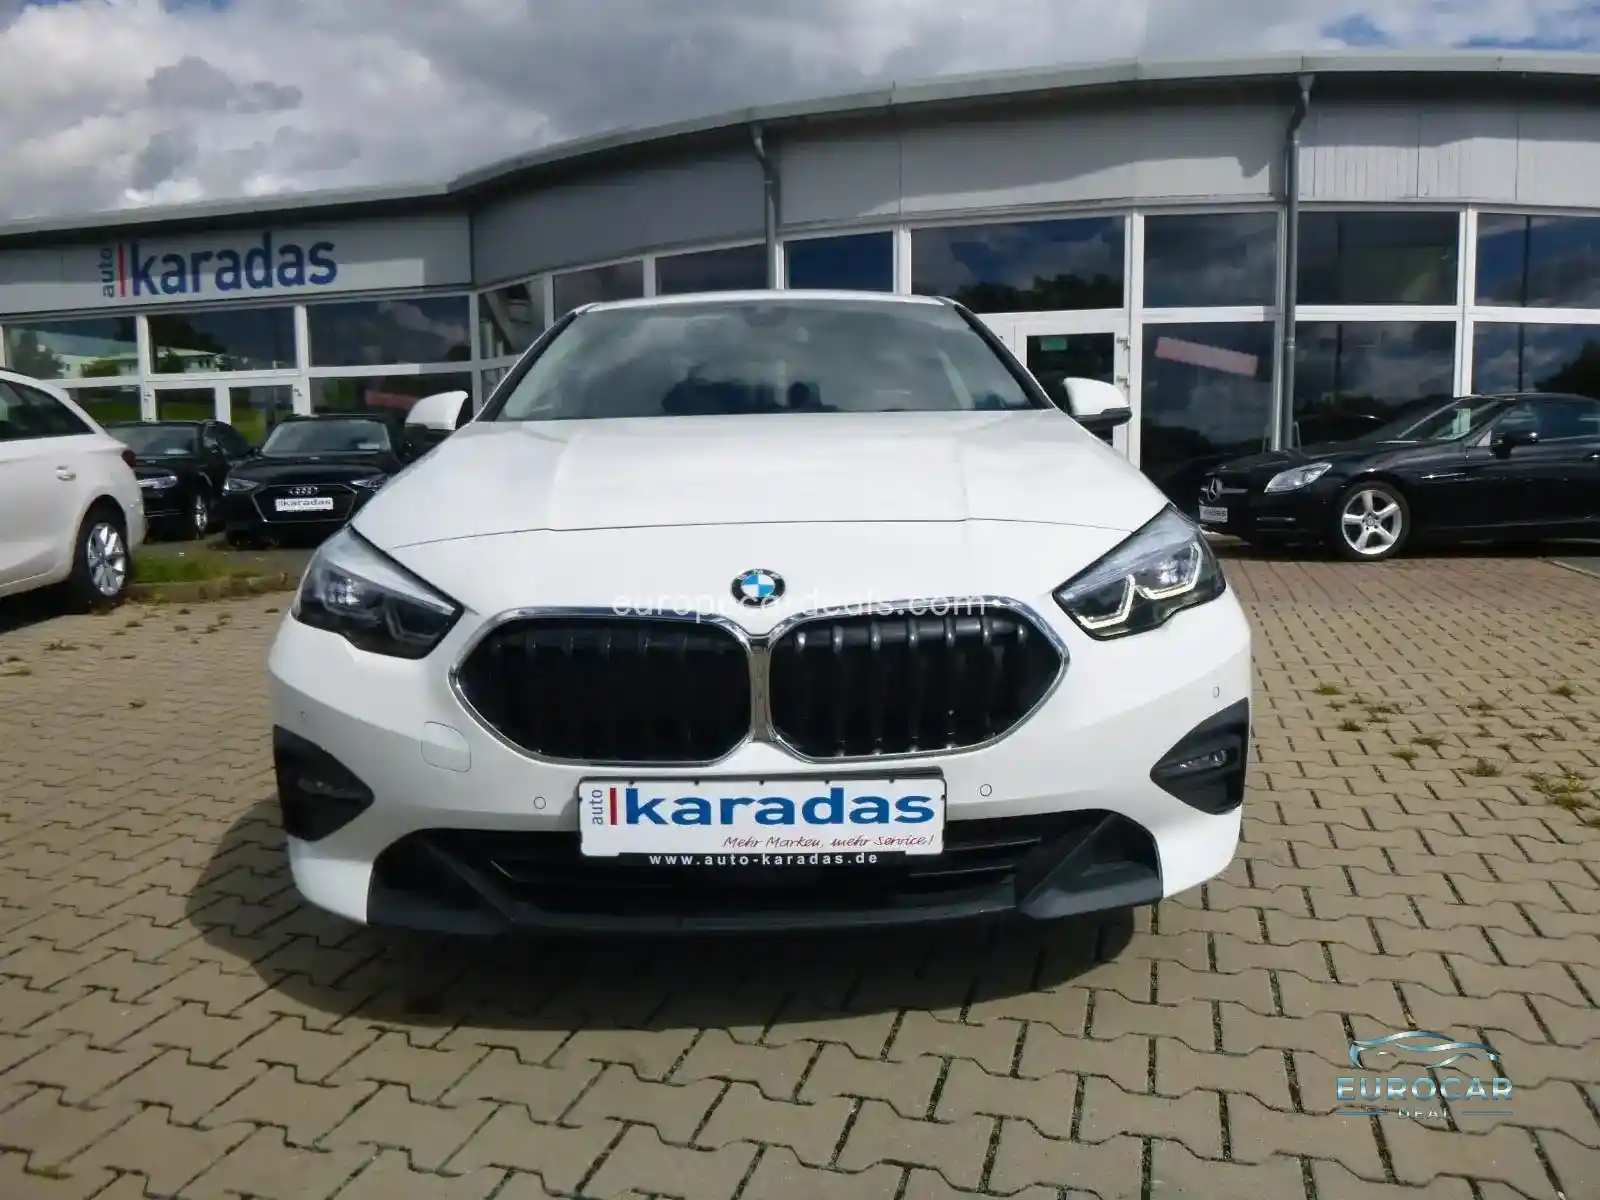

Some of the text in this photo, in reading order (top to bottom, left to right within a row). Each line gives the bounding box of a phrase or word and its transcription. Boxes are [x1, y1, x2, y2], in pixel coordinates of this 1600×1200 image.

[98, 247, 115, 298] auto
[131, 231, 338, 297] karadas
[591, 788, 604, 826] auto
[625, 787, 935, 826] karadas
[649, 853, 878, 866] www.auto-karadas.de
[723, 836, 762, 848] Mehr
[765, 836, 825, 849] Marken,
[831, 835, 869, 847] mehr
